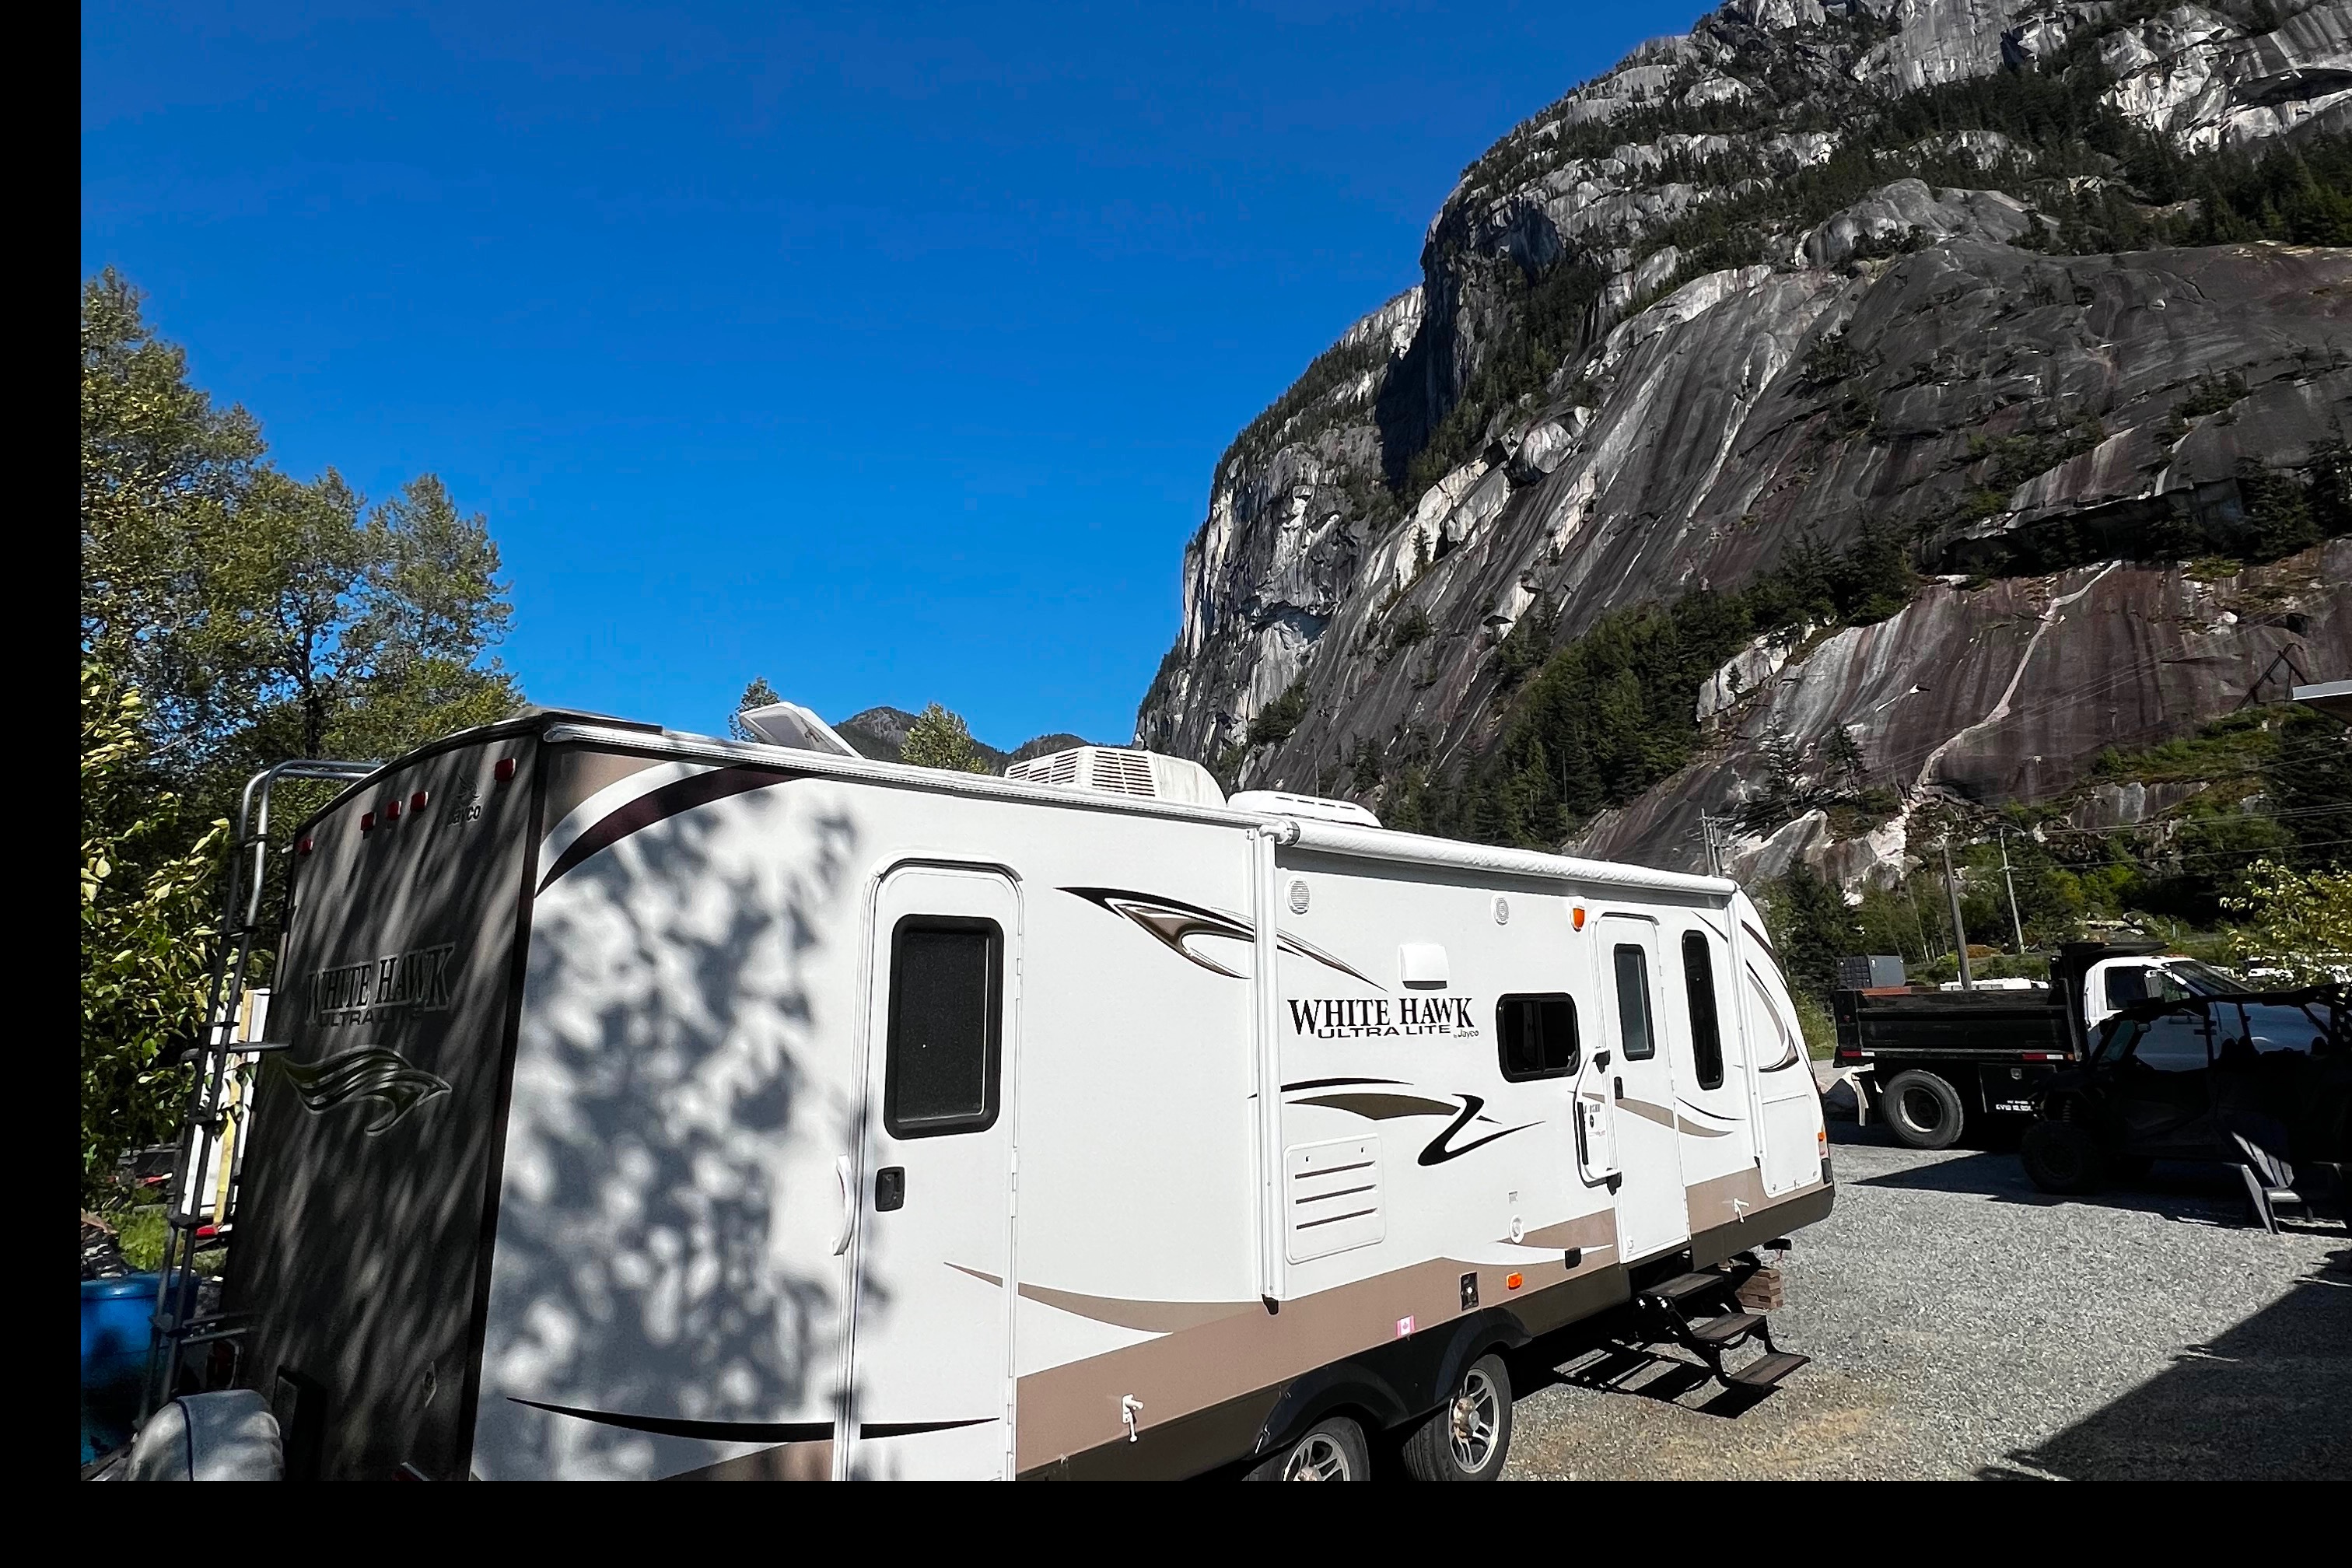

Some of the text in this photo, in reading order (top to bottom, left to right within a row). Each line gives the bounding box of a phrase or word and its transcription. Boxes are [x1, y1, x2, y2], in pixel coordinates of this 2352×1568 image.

[307, 947, 453, 1021] WHITE HAWK
[1287, 998, 1475, 1035] WHITE HAWK
[1318, 1024, 1451, 1039] ULTRA LITE
[1458, 1029, 1479, 1039] Jayco
